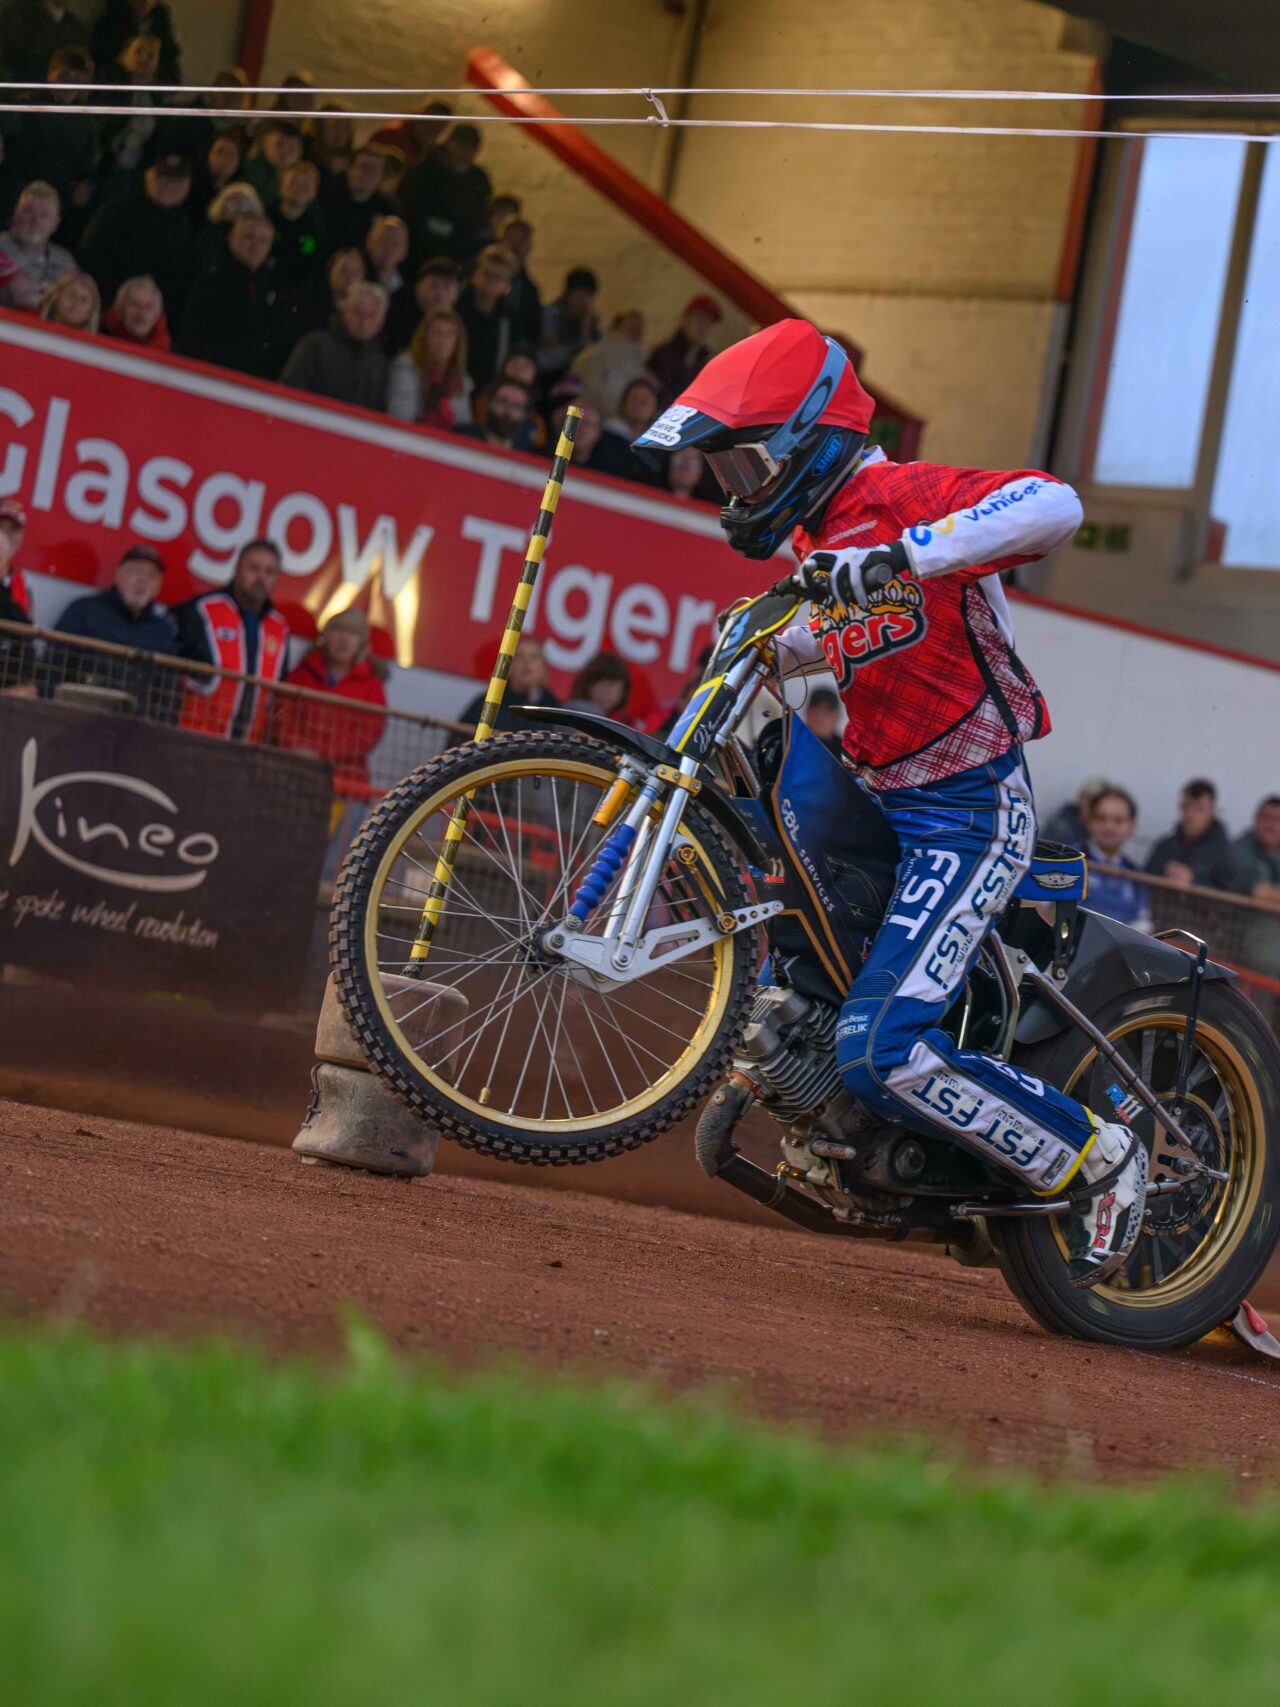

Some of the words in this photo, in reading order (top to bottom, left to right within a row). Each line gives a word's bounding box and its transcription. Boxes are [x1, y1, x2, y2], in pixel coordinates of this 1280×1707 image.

[461, 514, 730, 674] Tiger
[9, 737, 219, 892] Kineo
[799, 848, 836, 913] SERVICES
[888, 848, 961, 941] FST
[924, 914, 970, 991] FST
[911, 1075, 985, 1128] FST
[976, 1120, 1046, 1167] FST
